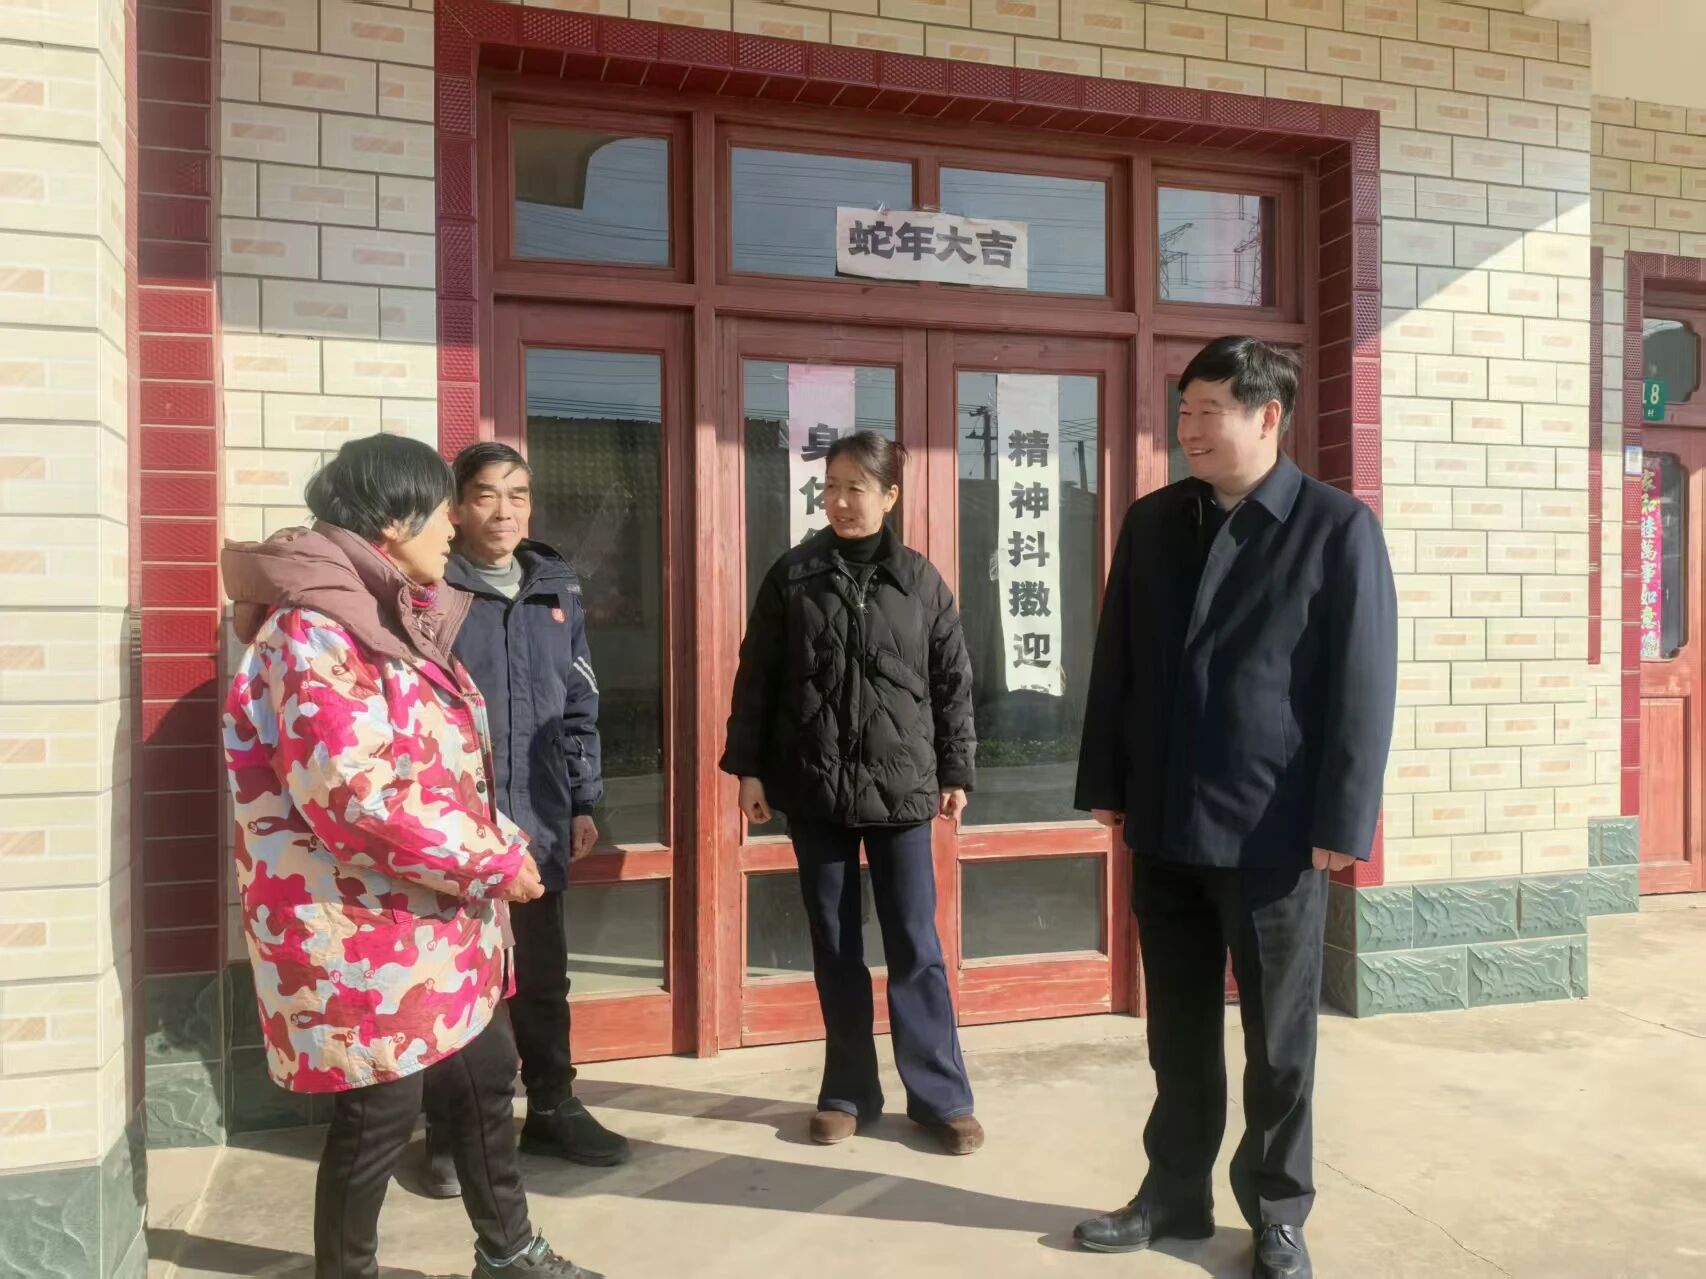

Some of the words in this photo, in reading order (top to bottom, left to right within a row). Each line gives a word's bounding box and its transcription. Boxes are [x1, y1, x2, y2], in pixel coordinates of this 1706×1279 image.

[848, 219, 1017, 268] 蛇年大吉
[1008, 429, 1051, 693] 精神抖擞迎
